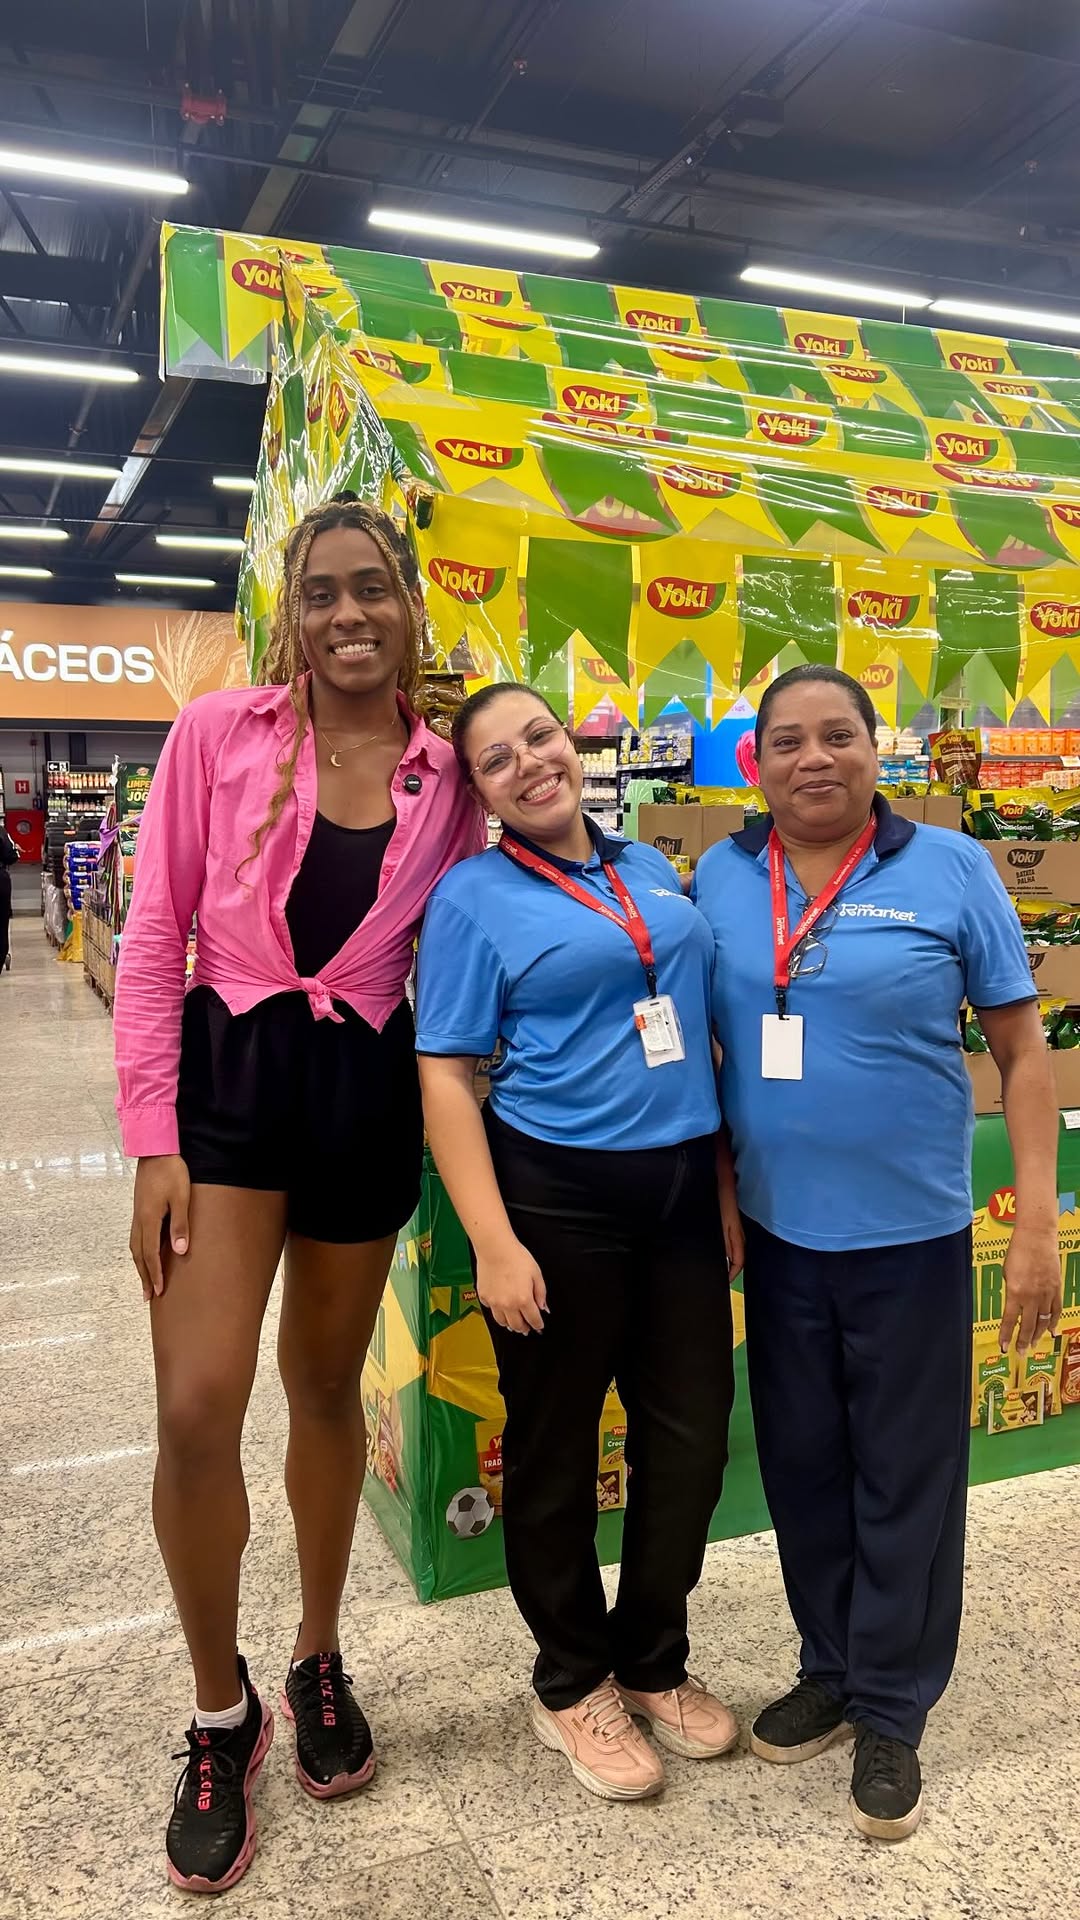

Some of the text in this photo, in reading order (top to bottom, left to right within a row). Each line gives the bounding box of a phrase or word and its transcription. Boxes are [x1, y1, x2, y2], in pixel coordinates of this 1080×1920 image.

[239, 263, 282, 290] Yok
[447, 282, 495, 303] Yoki
[632, 312, 676, 332] Yoki
[801, 335, 840, 357] Yoki
[955, 354, 993, 371] Yoki
[569, 388, 620, 412] Yoki
[764, 414, 810, 437] Yoki
[443, 441, 503, 464] Yoki
[941, 436, 984, 456] Yoki
[674, 468, 723, 491] Yoki
[875, 490, 922, 509] Yoki
[434, 560, 485, 594] Yoki
[656, 583, 708, 608] Yoki
[858, 596, 902, 620] Yoki
[1036, 606, 1080, 628] Yoki
[1002, 806, 1025, 815] Yoki
[1011, 851, 1036, 864] Yoki
